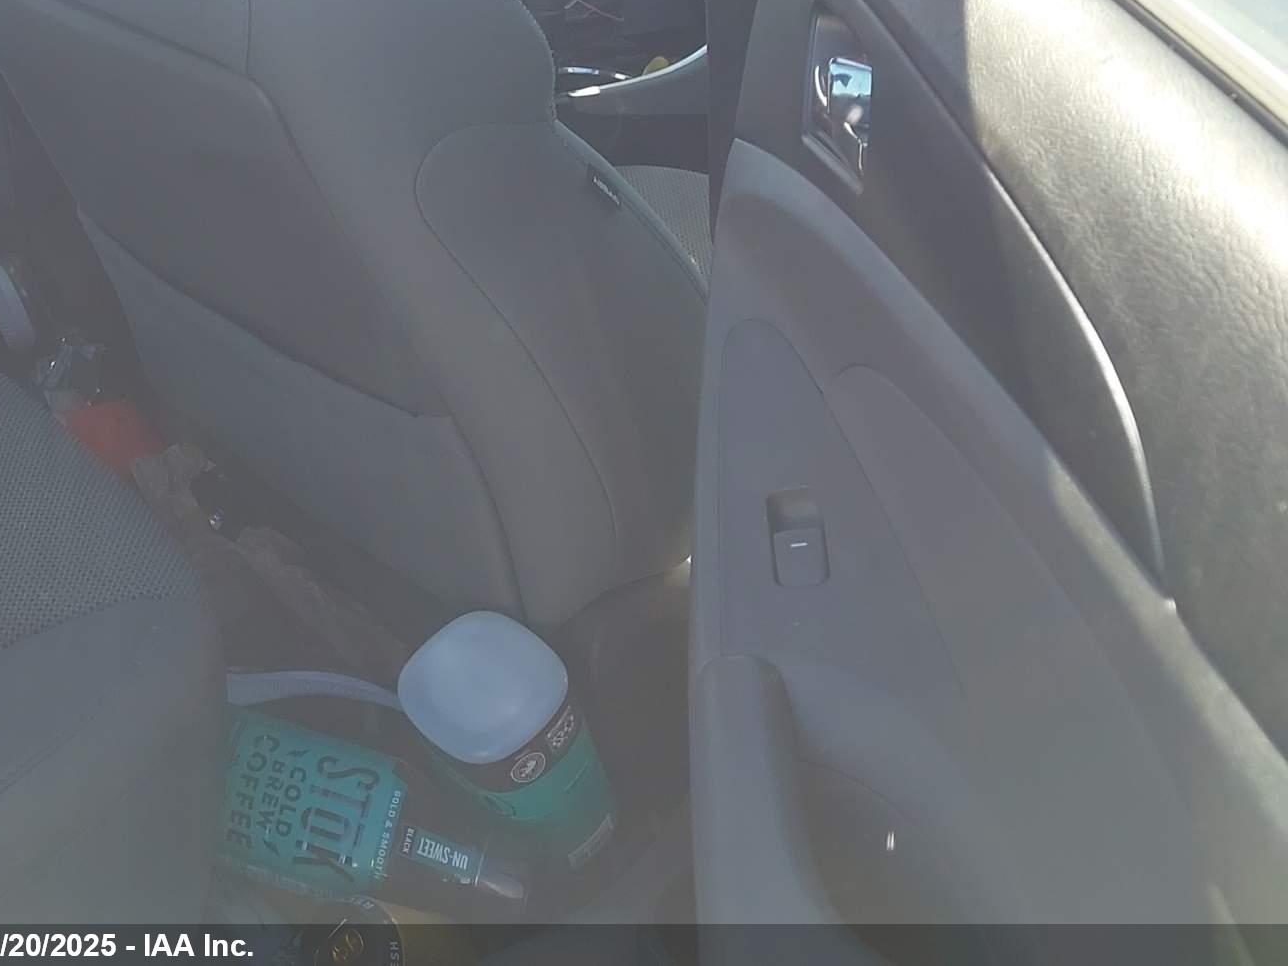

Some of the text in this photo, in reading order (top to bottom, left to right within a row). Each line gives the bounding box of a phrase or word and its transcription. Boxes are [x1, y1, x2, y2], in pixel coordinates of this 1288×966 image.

[225, 734, 281, 849] COFFEE
[255, 760, 286, 834] BREW
[275, 766, 307, 837] COLD
[402, 827, 415, 854] BLACK
[416, 837, 469, 871] UN-SWEET
